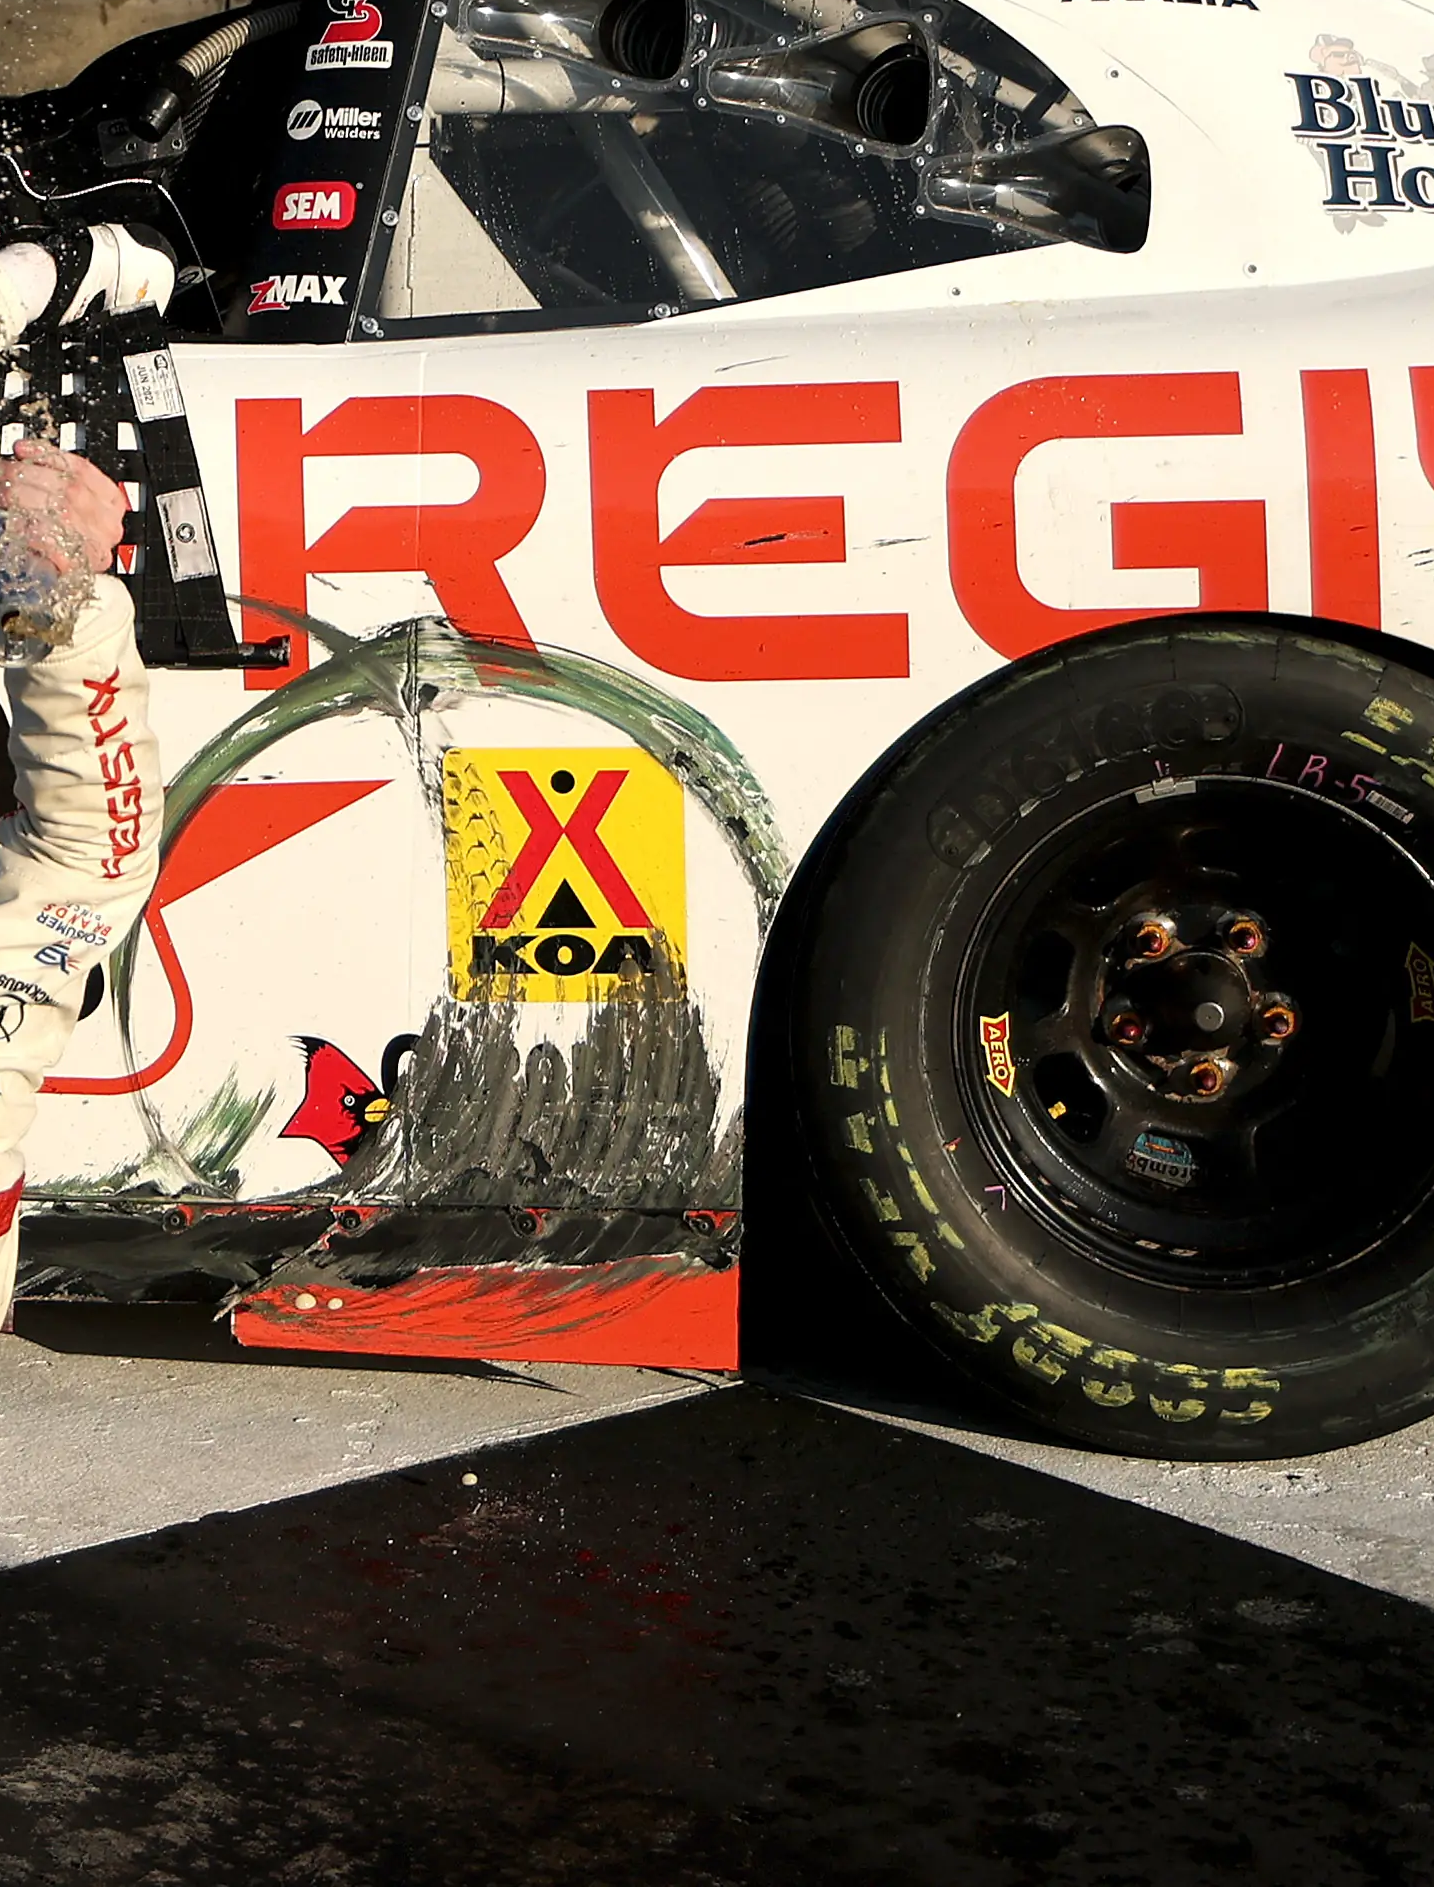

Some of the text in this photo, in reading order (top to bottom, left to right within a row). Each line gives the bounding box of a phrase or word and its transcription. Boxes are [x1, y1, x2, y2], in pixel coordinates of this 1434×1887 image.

[324, 107, 382, 128] Miller
[324, 127, 382, 142] Welders
[281, 191, 342, 222] SEM
[471, 933, 657, 977] KOA
[985, 1027, 1011, 1084] AERO
